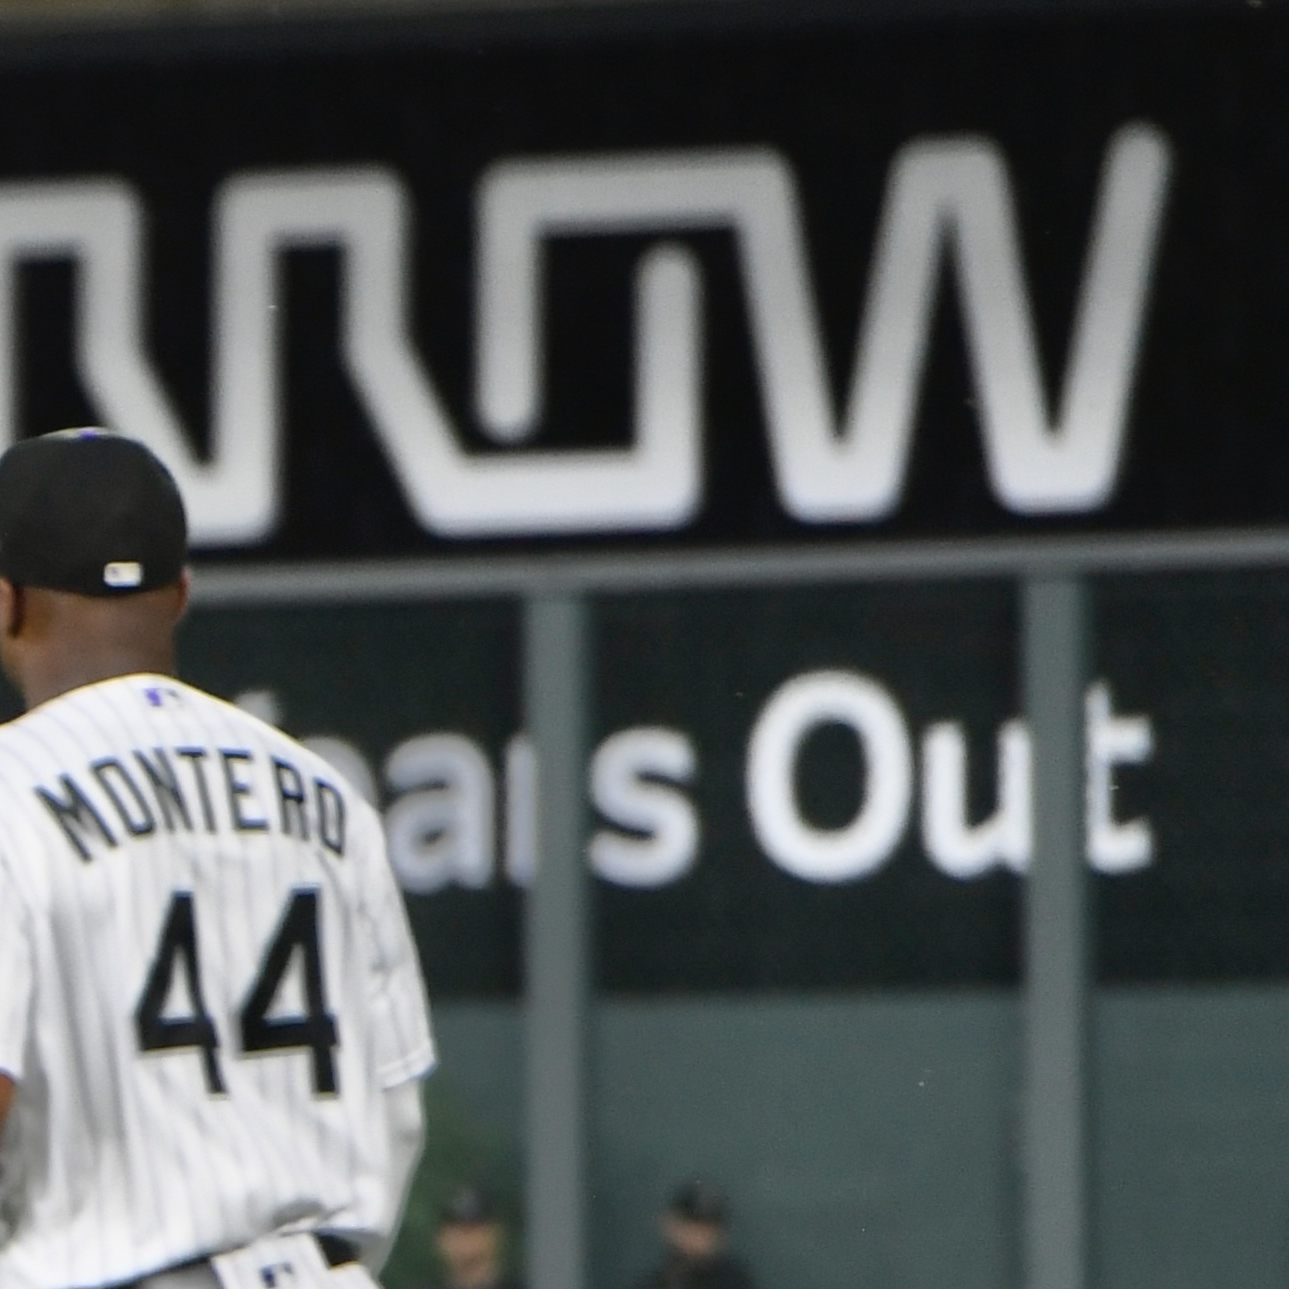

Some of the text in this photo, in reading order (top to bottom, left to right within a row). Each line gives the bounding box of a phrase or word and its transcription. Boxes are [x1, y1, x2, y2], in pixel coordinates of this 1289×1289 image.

[34, 746, 345, 864] MONTERO
[743, 667, 1154, 886] Out
[133, 886, 340, 1098] 44
